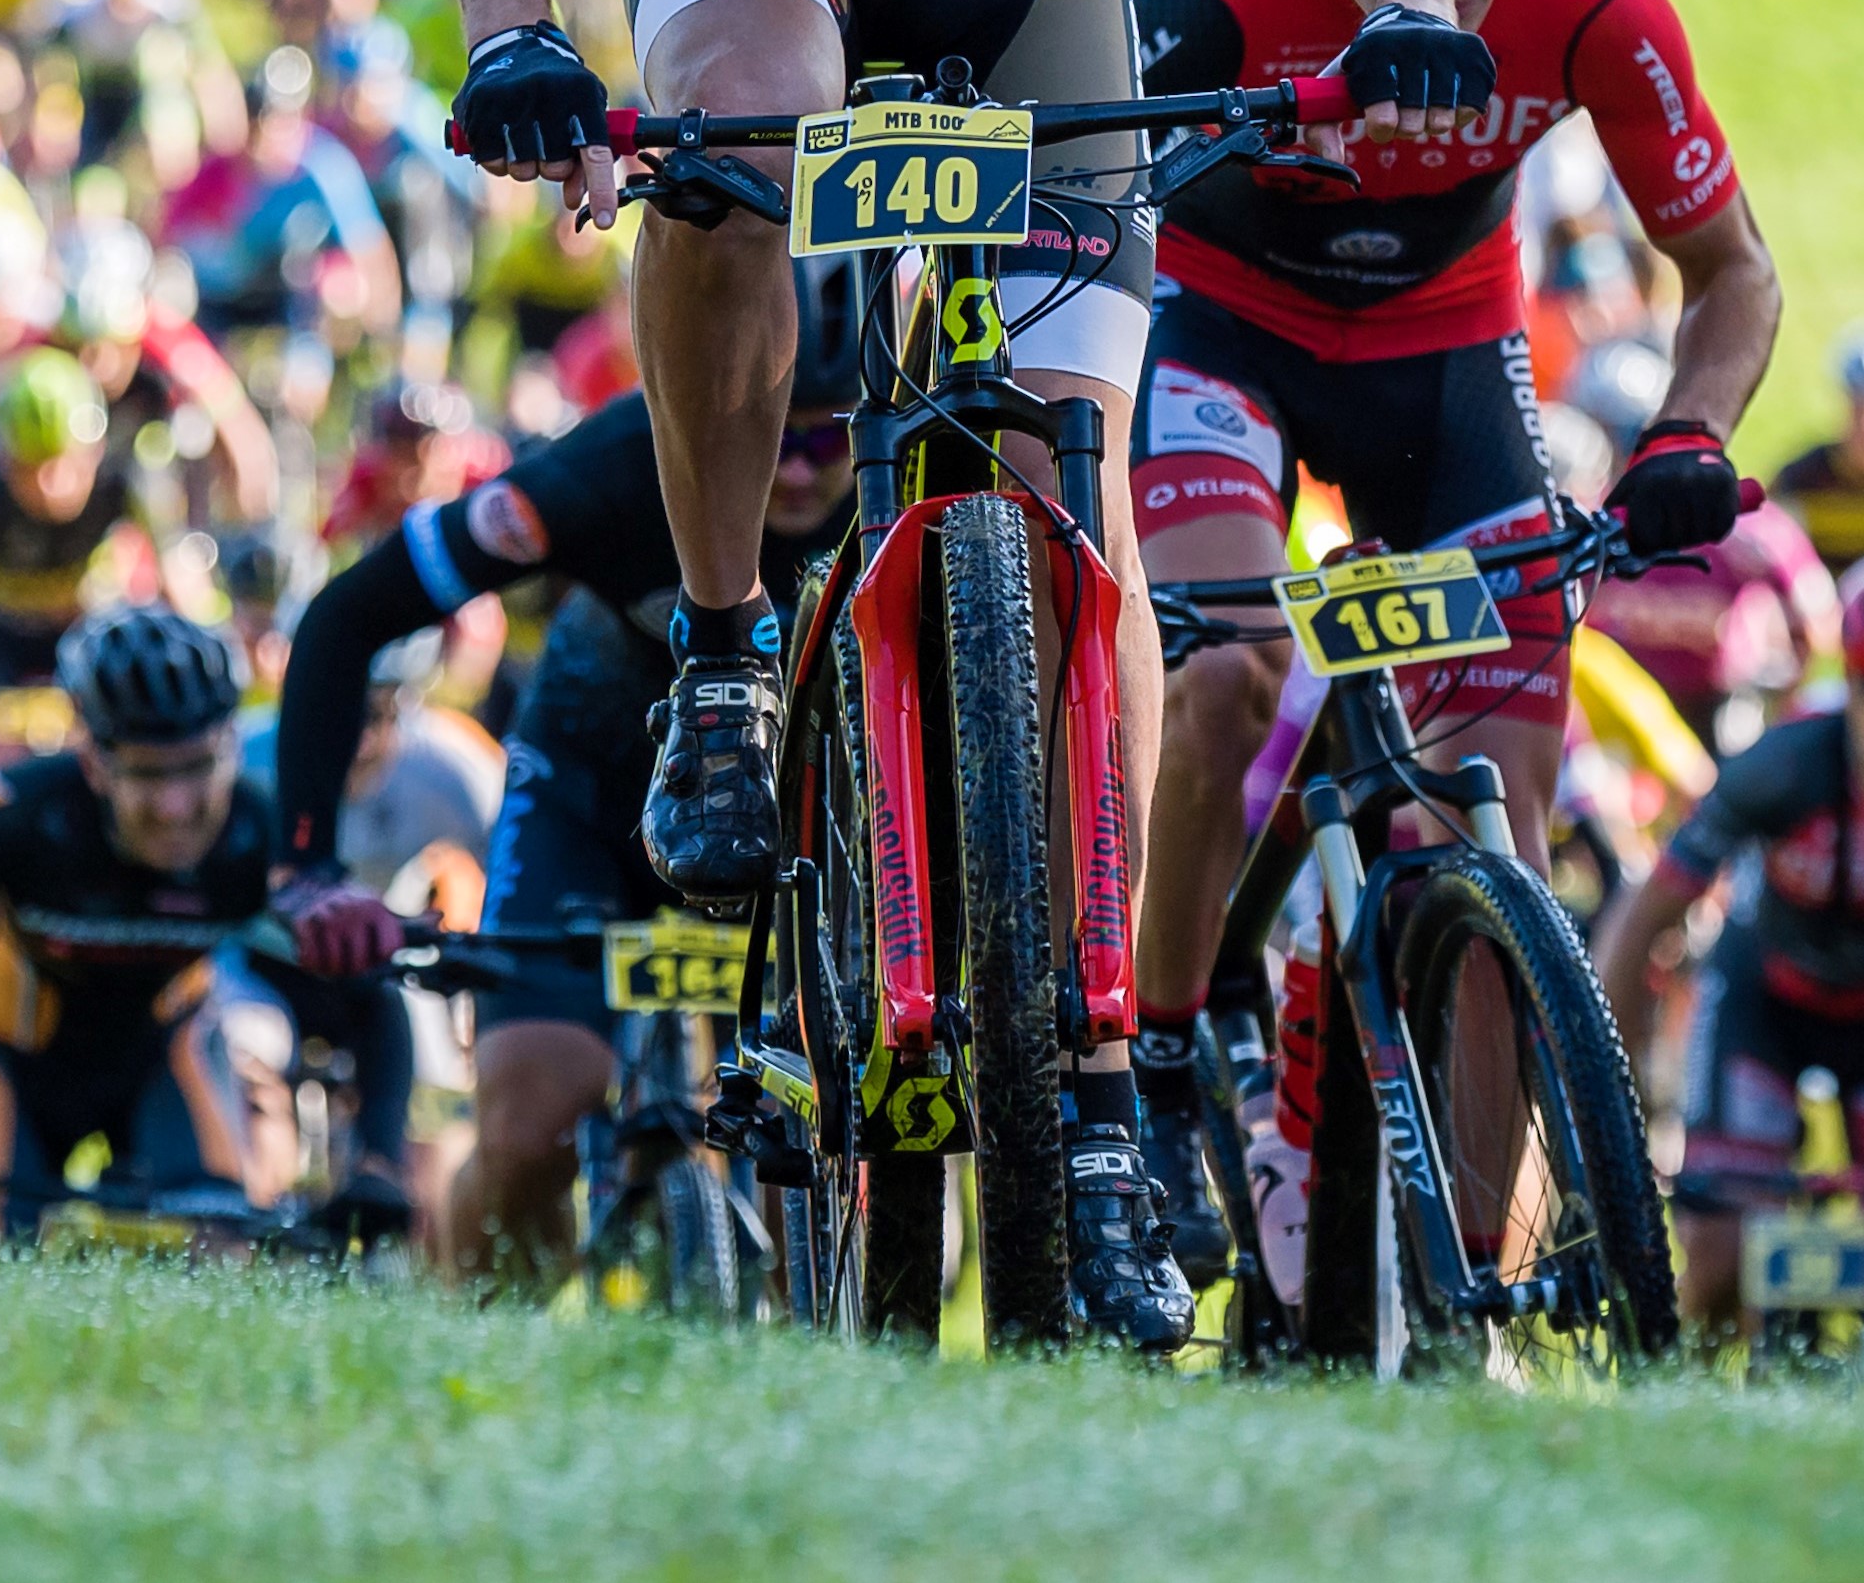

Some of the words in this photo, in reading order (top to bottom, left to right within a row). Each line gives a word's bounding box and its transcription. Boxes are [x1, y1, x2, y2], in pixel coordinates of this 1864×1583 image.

[1634, 37, 1689, 138] TREK
[809, 125, 844, 138] MTB
[885, 112, 922, 130] MTB
[928, 113, 963, 131] 100
[808, 135, 844, 150] 100
[844, 156, 979, 229] 140
[1336, 588, 1451, 652] 167
